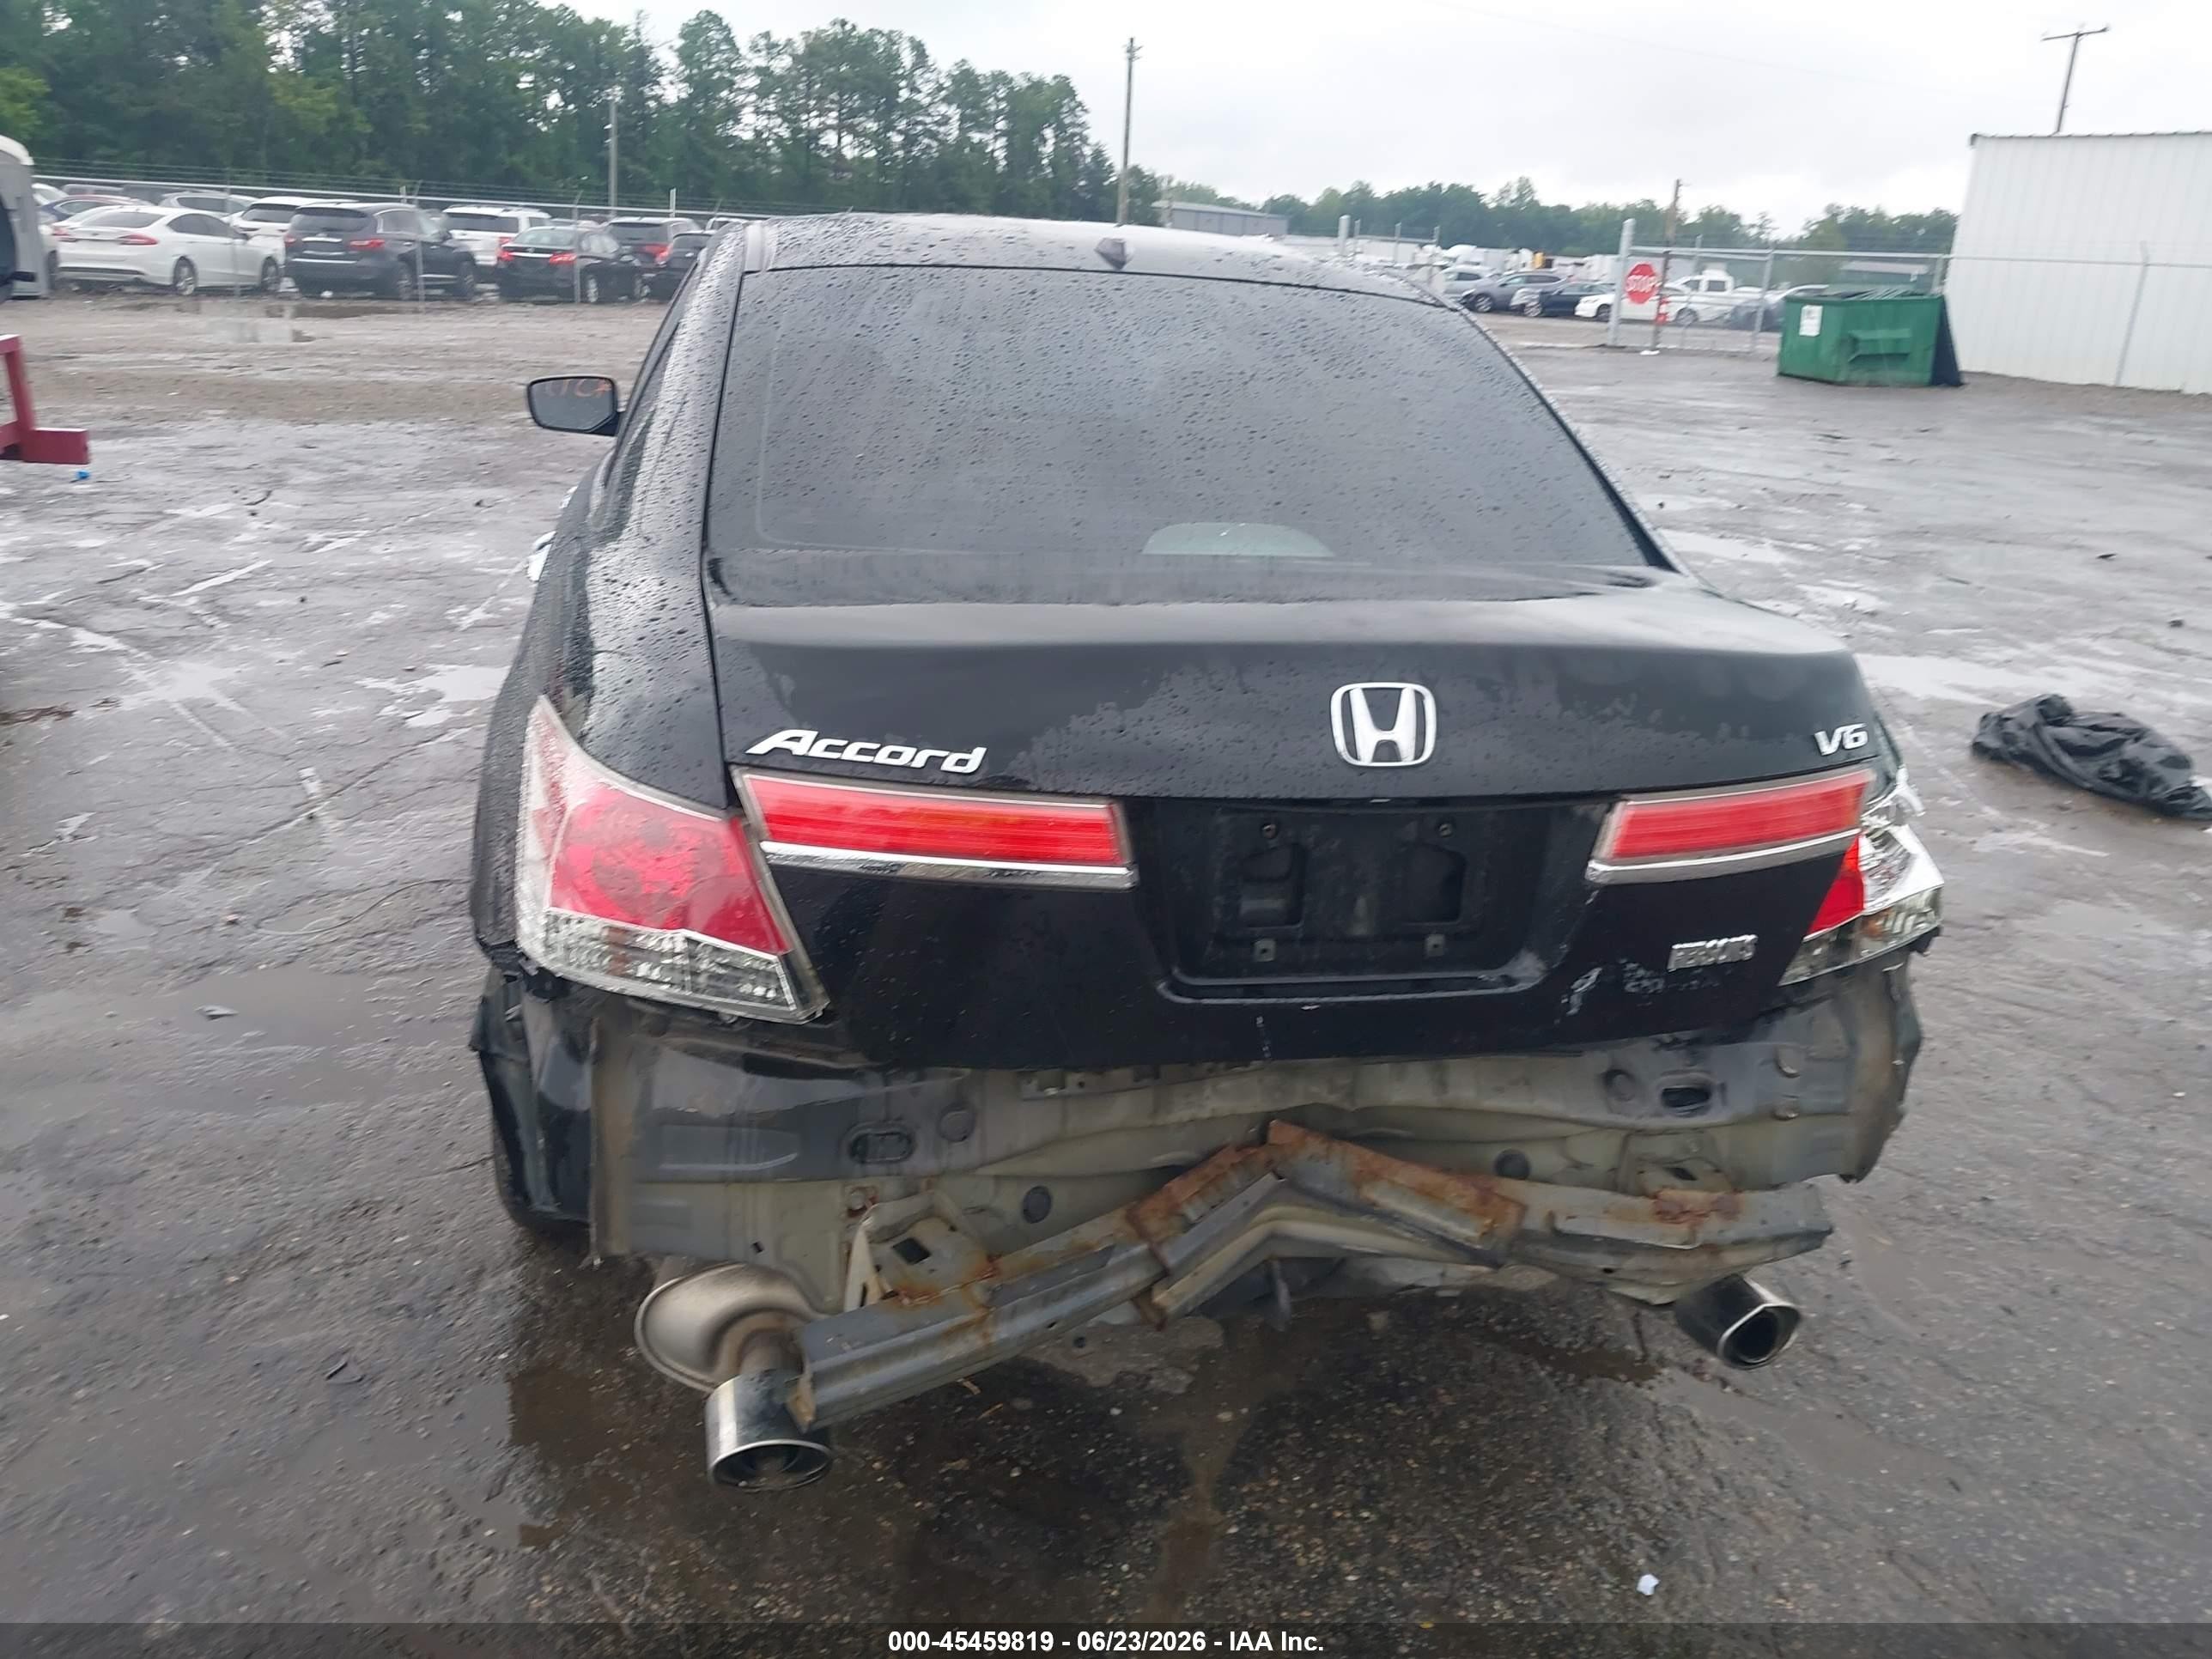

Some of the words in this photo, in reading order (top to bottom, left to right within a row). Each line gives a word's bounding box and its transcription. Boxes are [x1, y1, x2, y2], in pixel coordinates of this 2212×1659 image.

[1626, 274, 1656, 293] STOP
[744, 728, 988, 775] Accord
[1814, 722, 1869, 757] V6
